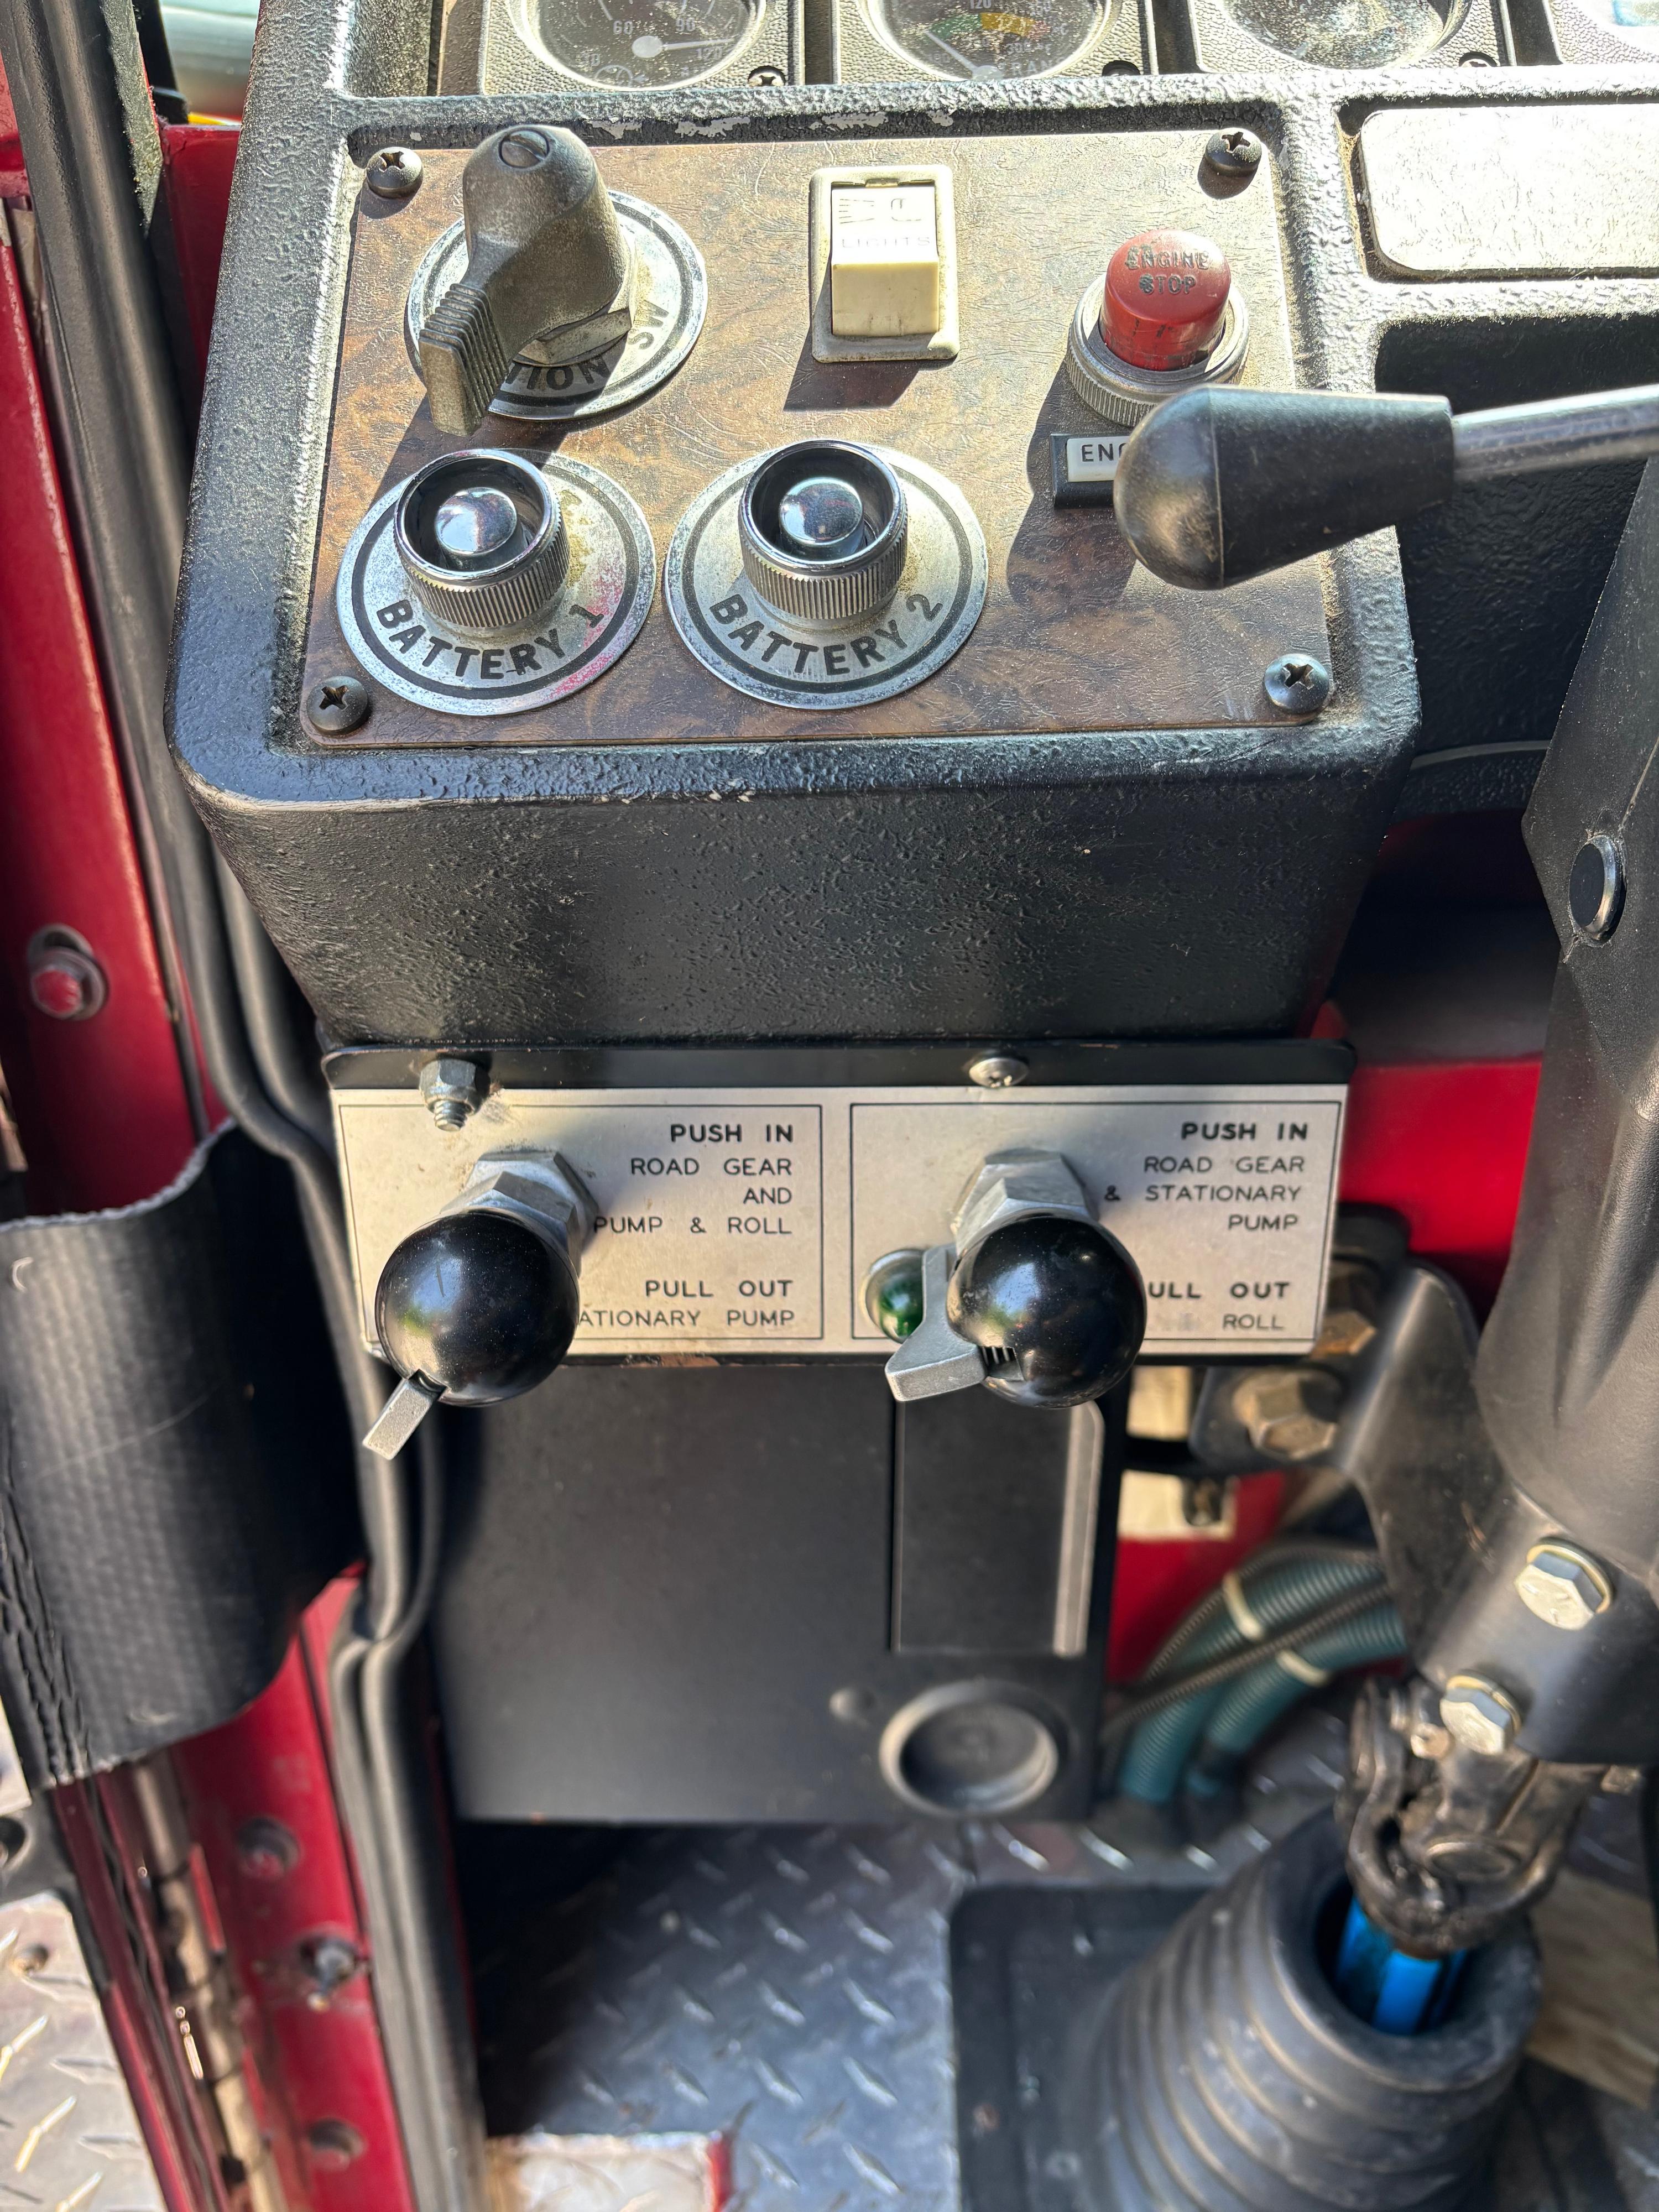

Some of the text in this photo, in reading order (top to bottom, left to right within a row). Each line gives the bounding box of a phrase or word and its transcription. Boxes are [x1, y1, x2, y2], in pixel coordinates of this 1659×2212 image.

[613, 20, 633, 35] 60
[842, 236, 930, 248] LIGHTS
[1125, 246, 1209, 270] ENGINE
[1139, 273, 1196, 295] STOP
[376, 599, 604, 680] BATTERY 1
[709, 594, 943, 676] BATTERY 2
[670, 1124, 794, 1142] PUSH IN
[1181, 1122, 1308, 1140] PUSH IN
[631, 1157, 792, 1176] ROAD GEAR
[1144, 1156, 1305, 1173] ROAD GEAR
[743, 1187, 792, 1205] AND
[1104, 1185, 1301, 1202] & STATIONARY
[593, 1216, 792, 1234] PUMP & ROLL
[1228, 1214, 1298, 1231] PUMP
[645, 1280, 794, 1298] PULL OUT
[1148, 1281, 1290, 1299] ULL OUT
[578, 1310, 795, 1327] ATIONARY PUMP
[1222, 1313, 1285, 1331] ROLL
